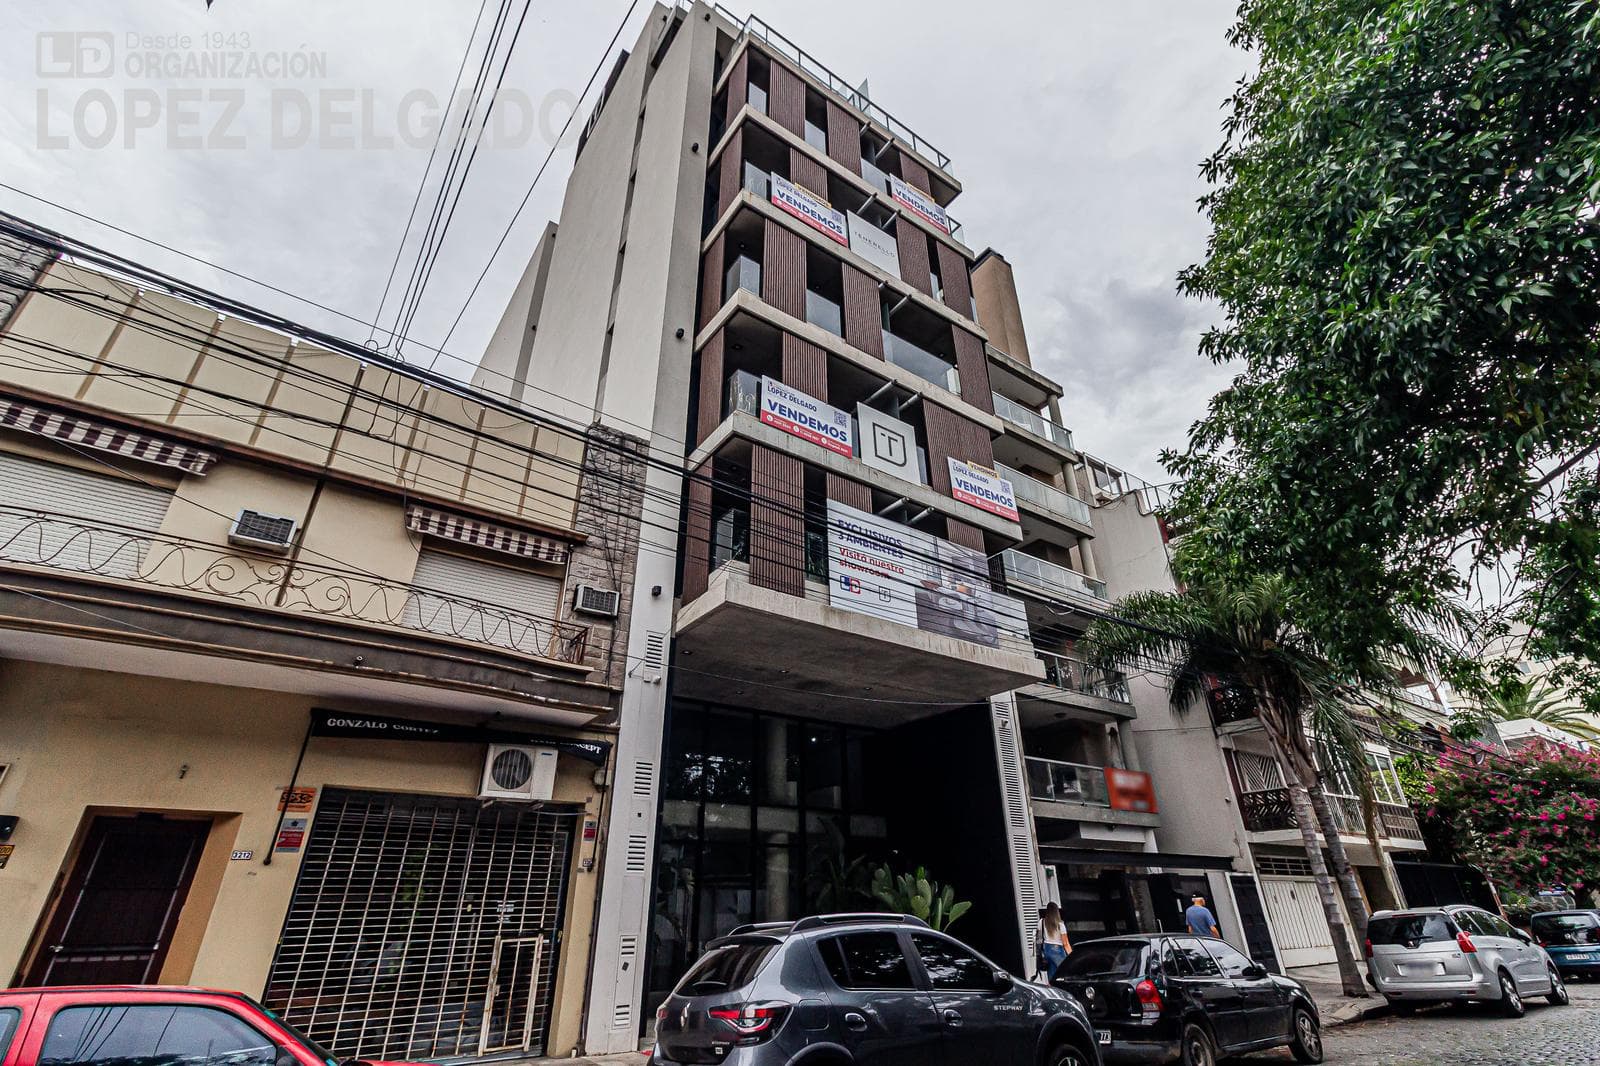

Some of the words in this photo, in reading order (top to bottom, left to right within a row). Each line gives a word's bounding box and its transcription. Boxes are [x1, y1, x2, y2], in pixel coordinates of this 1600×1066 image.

[777, 189, 843, 235] VENDEMOS
[895, 188, 945, 225] VENDEMOS
[767, 385, 788, 400] LOPEZ
[788, 393, 817, 412] DELGADO
[767, 398, 848, 442] VENDEMOS
[955, 477, 1014, 508] VENDEMOS
[838, 519, 904, 549] EXCLUSIVOS
[846, 533, 904, 559] AMBIENTES
[869, 558, 904, 575] nuestro
[327, 718, 388, 729] GONZALO
